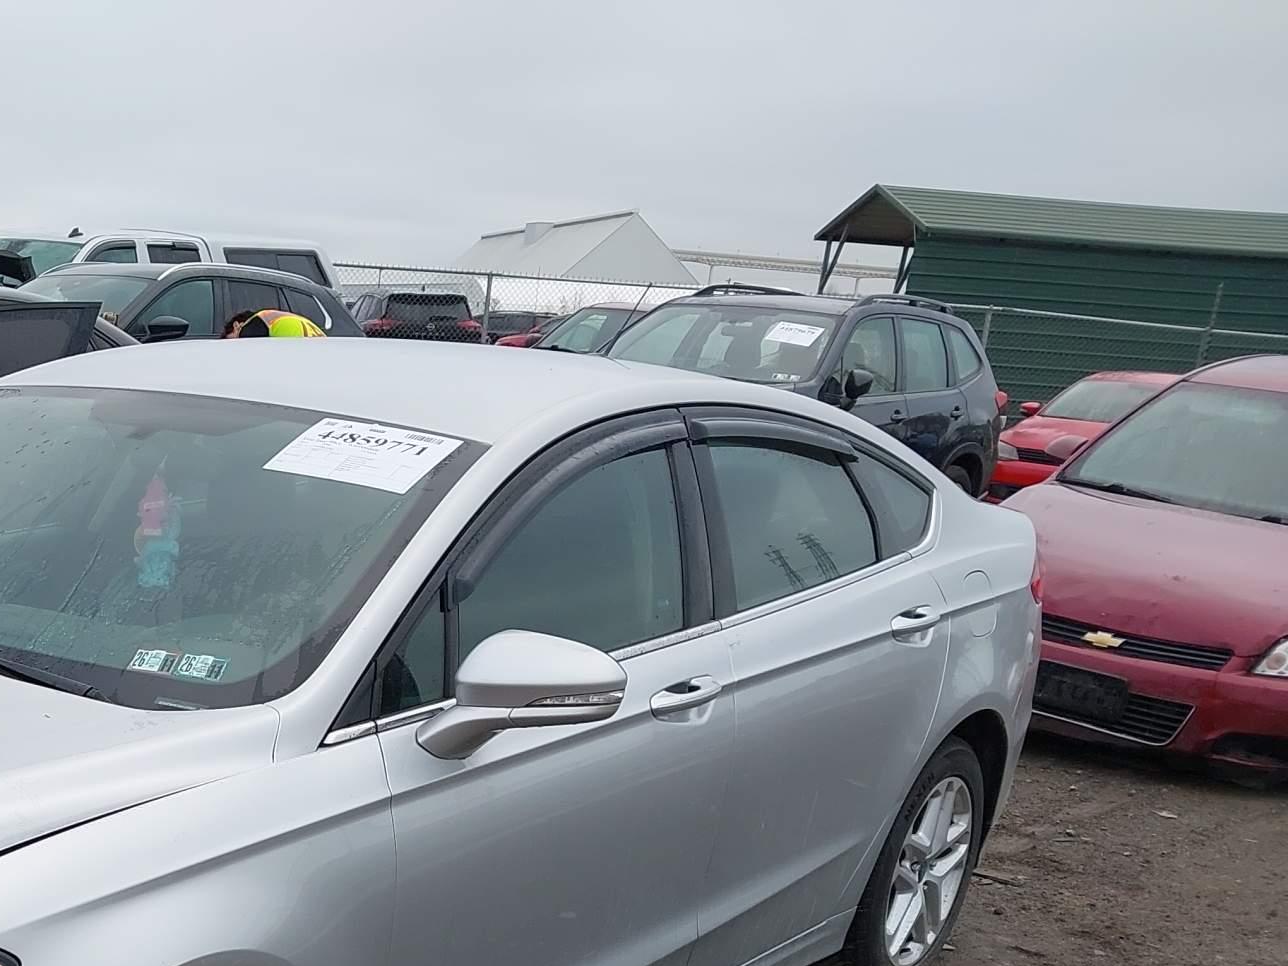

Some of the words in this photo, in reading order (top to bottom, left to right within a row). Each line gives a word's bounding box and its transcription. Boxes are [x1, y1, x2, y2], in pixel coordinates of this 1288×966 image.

[318, 430, 430, 457] 44859771
[132, 651, 149, 668] 26
[179, 655, 197, 673] 26
